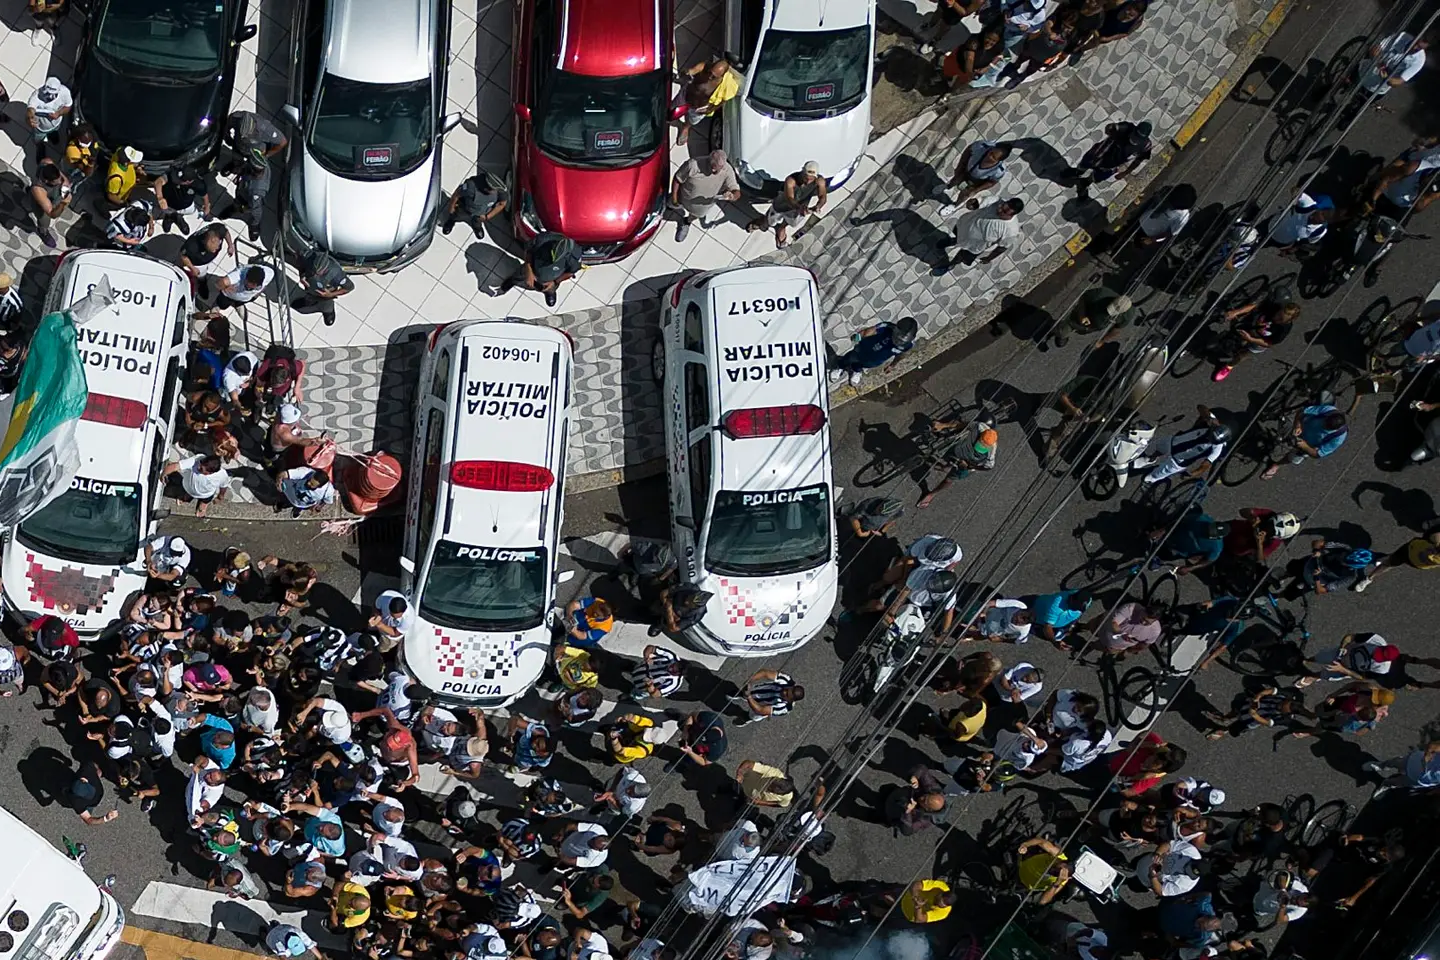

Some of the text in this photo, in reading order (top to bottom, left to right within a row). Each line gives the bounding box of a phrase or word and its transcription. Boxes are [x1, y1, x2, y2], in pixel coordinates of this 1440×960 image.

[728, 296, 800, 316] I-06317
[482, 346, 540, 363] I-06402
[723, 341, 811, 361] MILITAR
[726, 362, 812, 383] POLÍCIA
[467, 381, 549, 400] MILITAR
[467, 399, 547, 420] POLÍCIA
[69, 478, 117, 497] OLÍCIA
[742, 490, 803, 506] POLÍCIA
[456, 546, 526, 562] POLÍCIA
